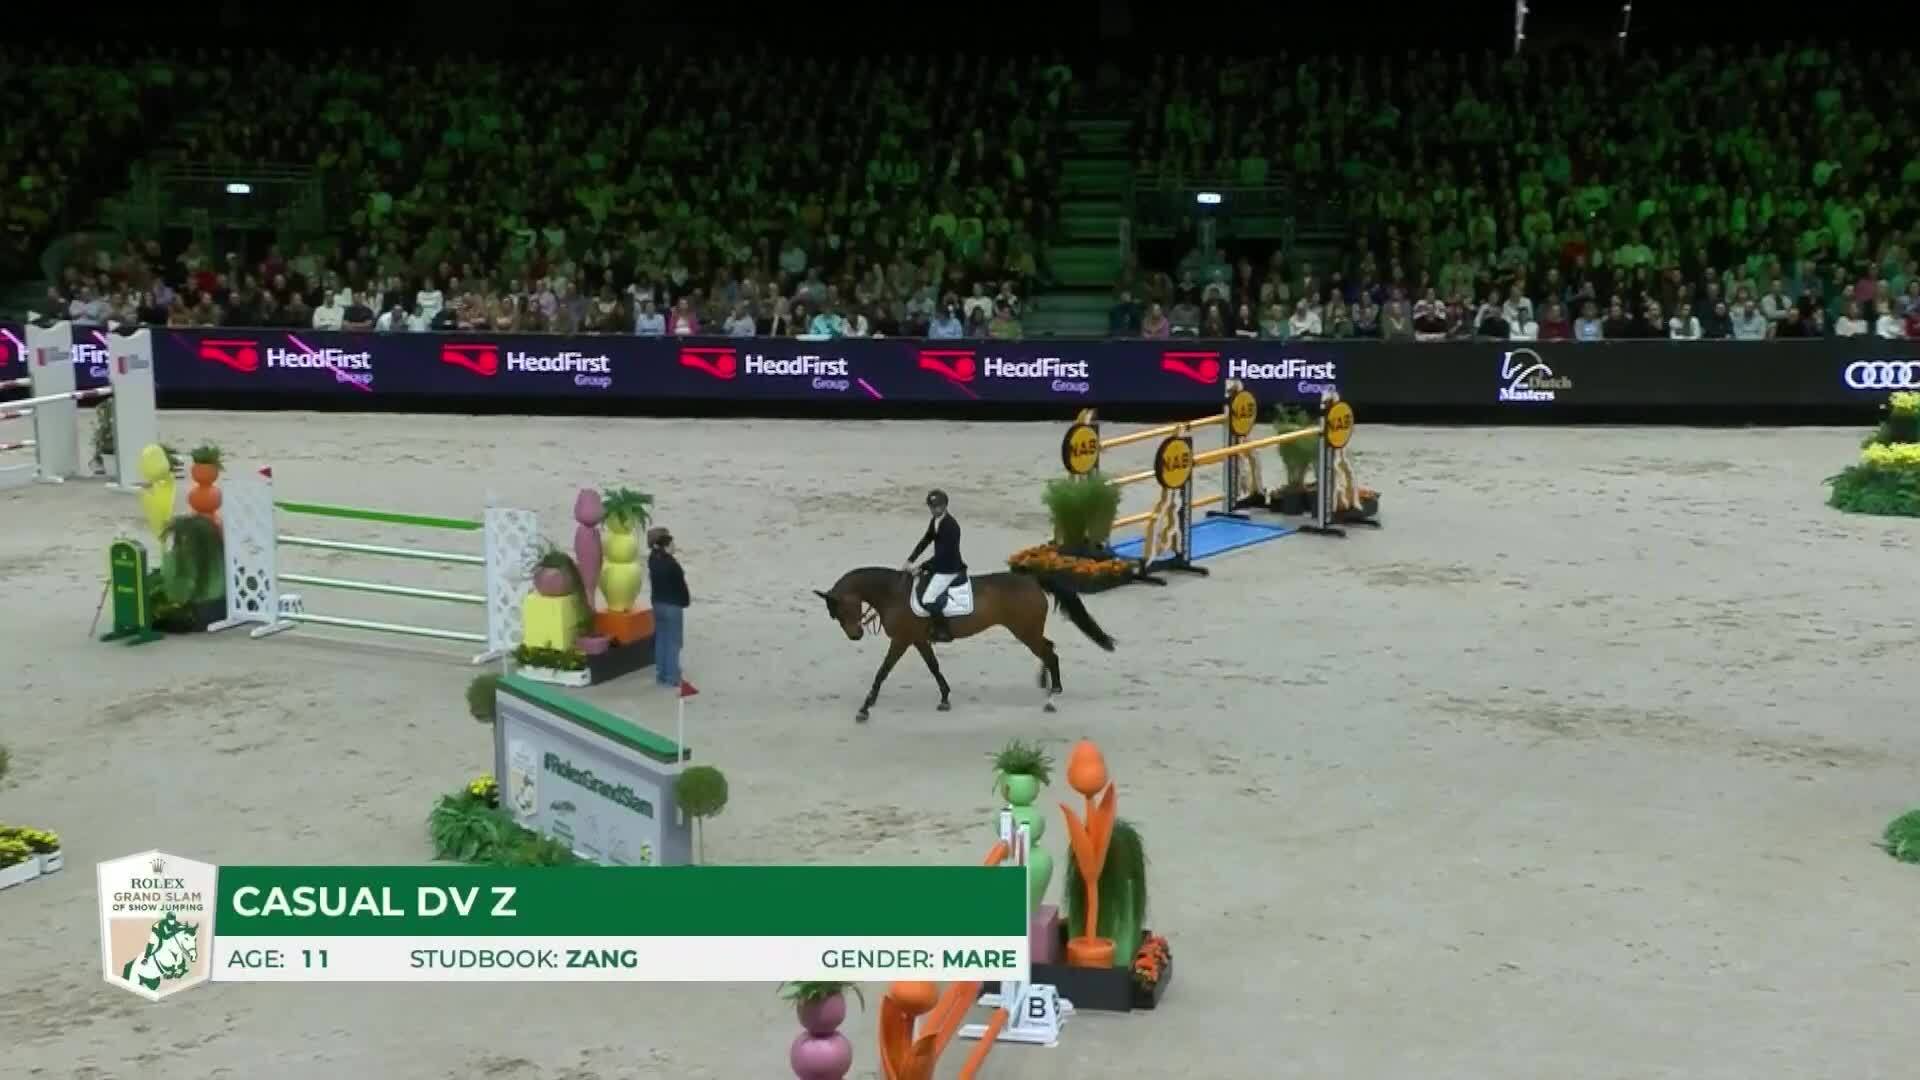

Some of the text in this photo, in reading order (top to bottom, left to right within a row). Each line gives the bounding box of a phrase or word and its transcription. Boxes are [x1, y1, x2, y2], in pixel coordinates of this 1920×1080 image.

[267, 348, 372, 369] HeadFirst
[507, 352, 611, 373] HeadFirst
[745, 355, 848, 376] HeadFirst
[984, 357, 1088, 378] HeadFirst
[1229, 359, 1336, 379] HeadFirst
[574, 374, 612, 389] Group
[812, 377, 849, 391] Group
[1052, 379, 1089, 394] Group
[1029, 996, 1047, 1018] B
